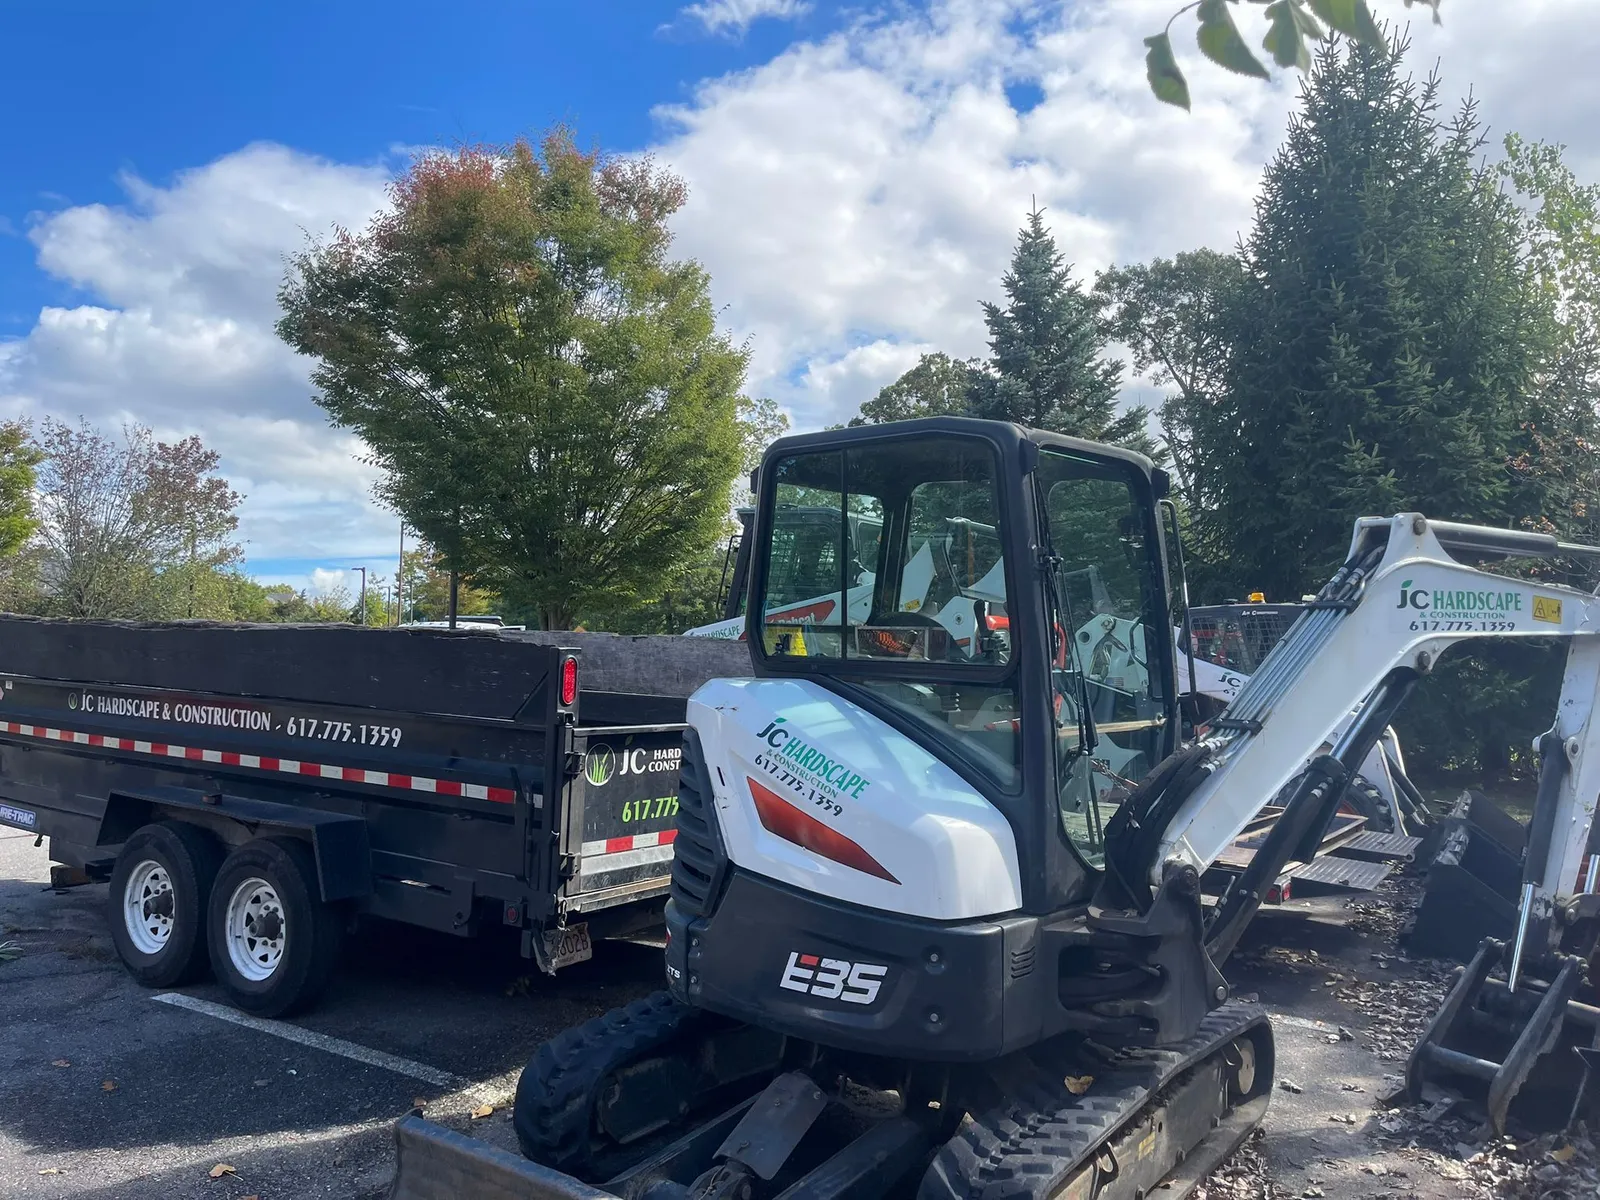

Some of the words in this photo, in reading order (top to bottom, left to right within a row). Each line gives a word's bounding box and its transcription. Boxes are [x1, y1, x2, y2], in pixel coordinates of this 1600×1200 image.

[1396, 589, 1430, 610] JC
[1433, 590, 1522, 611] HARDSCAPE
[1409, 620, 1516, 632] 617.775.1359
[1419, 611, 1426, 619] &
[1430, 611, 1506, 620] CONSTRUCTION
[81, 692, 94, 712] JC
[97, 696, 160, 719] HARDSCAPE
[162, 702, 172, 721] &
[174, 703, 271, 731] CONSTRUCTION
[286, 716, 402, 748] 617.775.1359
[620, 747, 647, 776] JC
[648, 759, 681, 773] CONST
[653, 748, 682, 760] HARD
[756, 721, 789, 748] JC
[781, 737, 871, 800] HARDSCAPE
[754, 754, 843, 817] 617.775.1359
[765, 748, 773, 757] &
[774, 753, 839, 799] CONSTRUCTION
[0, 807, 34, 825] RE-TRAC
[622, 796, 680, 823] 617.775
[779, 951, 888, 1005] E35
